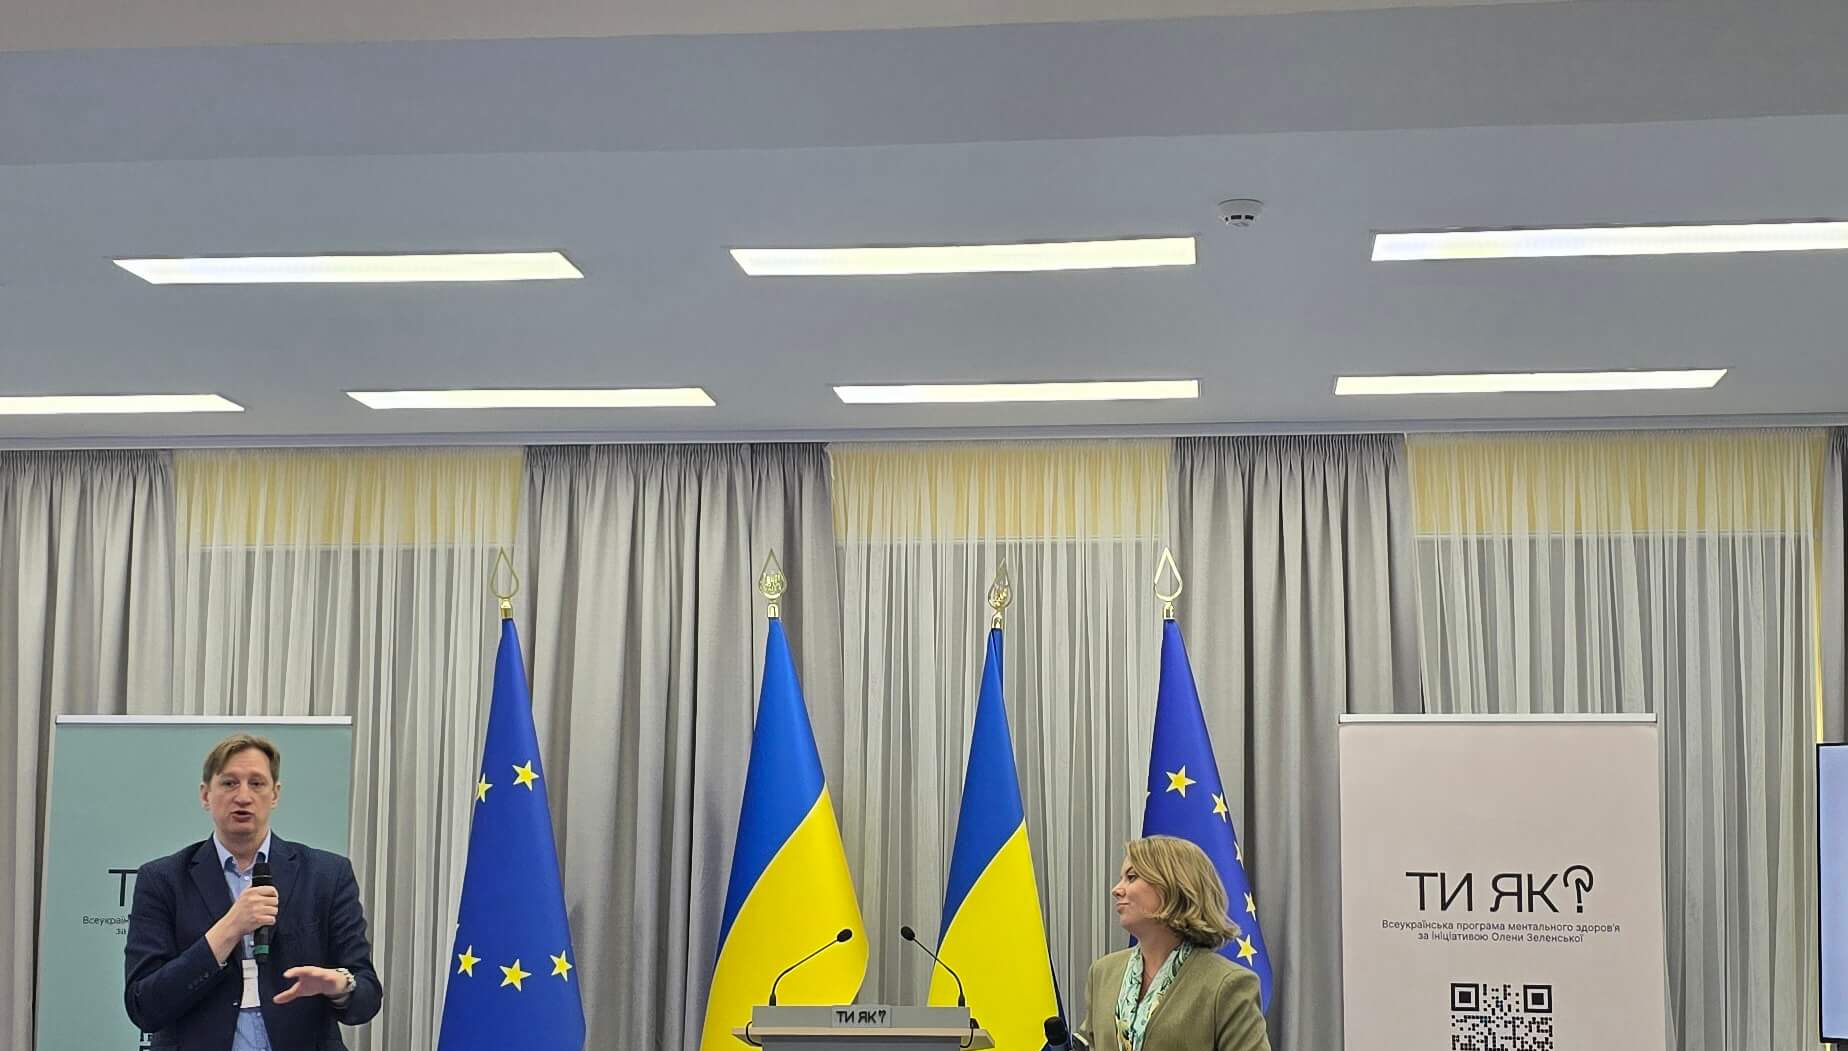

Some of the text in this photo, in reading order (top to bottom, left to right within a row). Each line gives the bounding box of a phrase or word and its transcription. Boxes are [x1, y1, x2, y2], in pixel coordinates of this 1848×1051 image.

[109, 869, 138, 906] Т
[1405, 871, 1473, 912] ТИ
[1382, 919, 1621, 933] Всеукраїнська програма ментального здоров'я
[1418, 932, 1429, 940] за
[1491, 932, 1524, 942] Олени
[1526, 932, 1584, 943] Зеленської
[836, 1011, 854, 1023] ТИ
